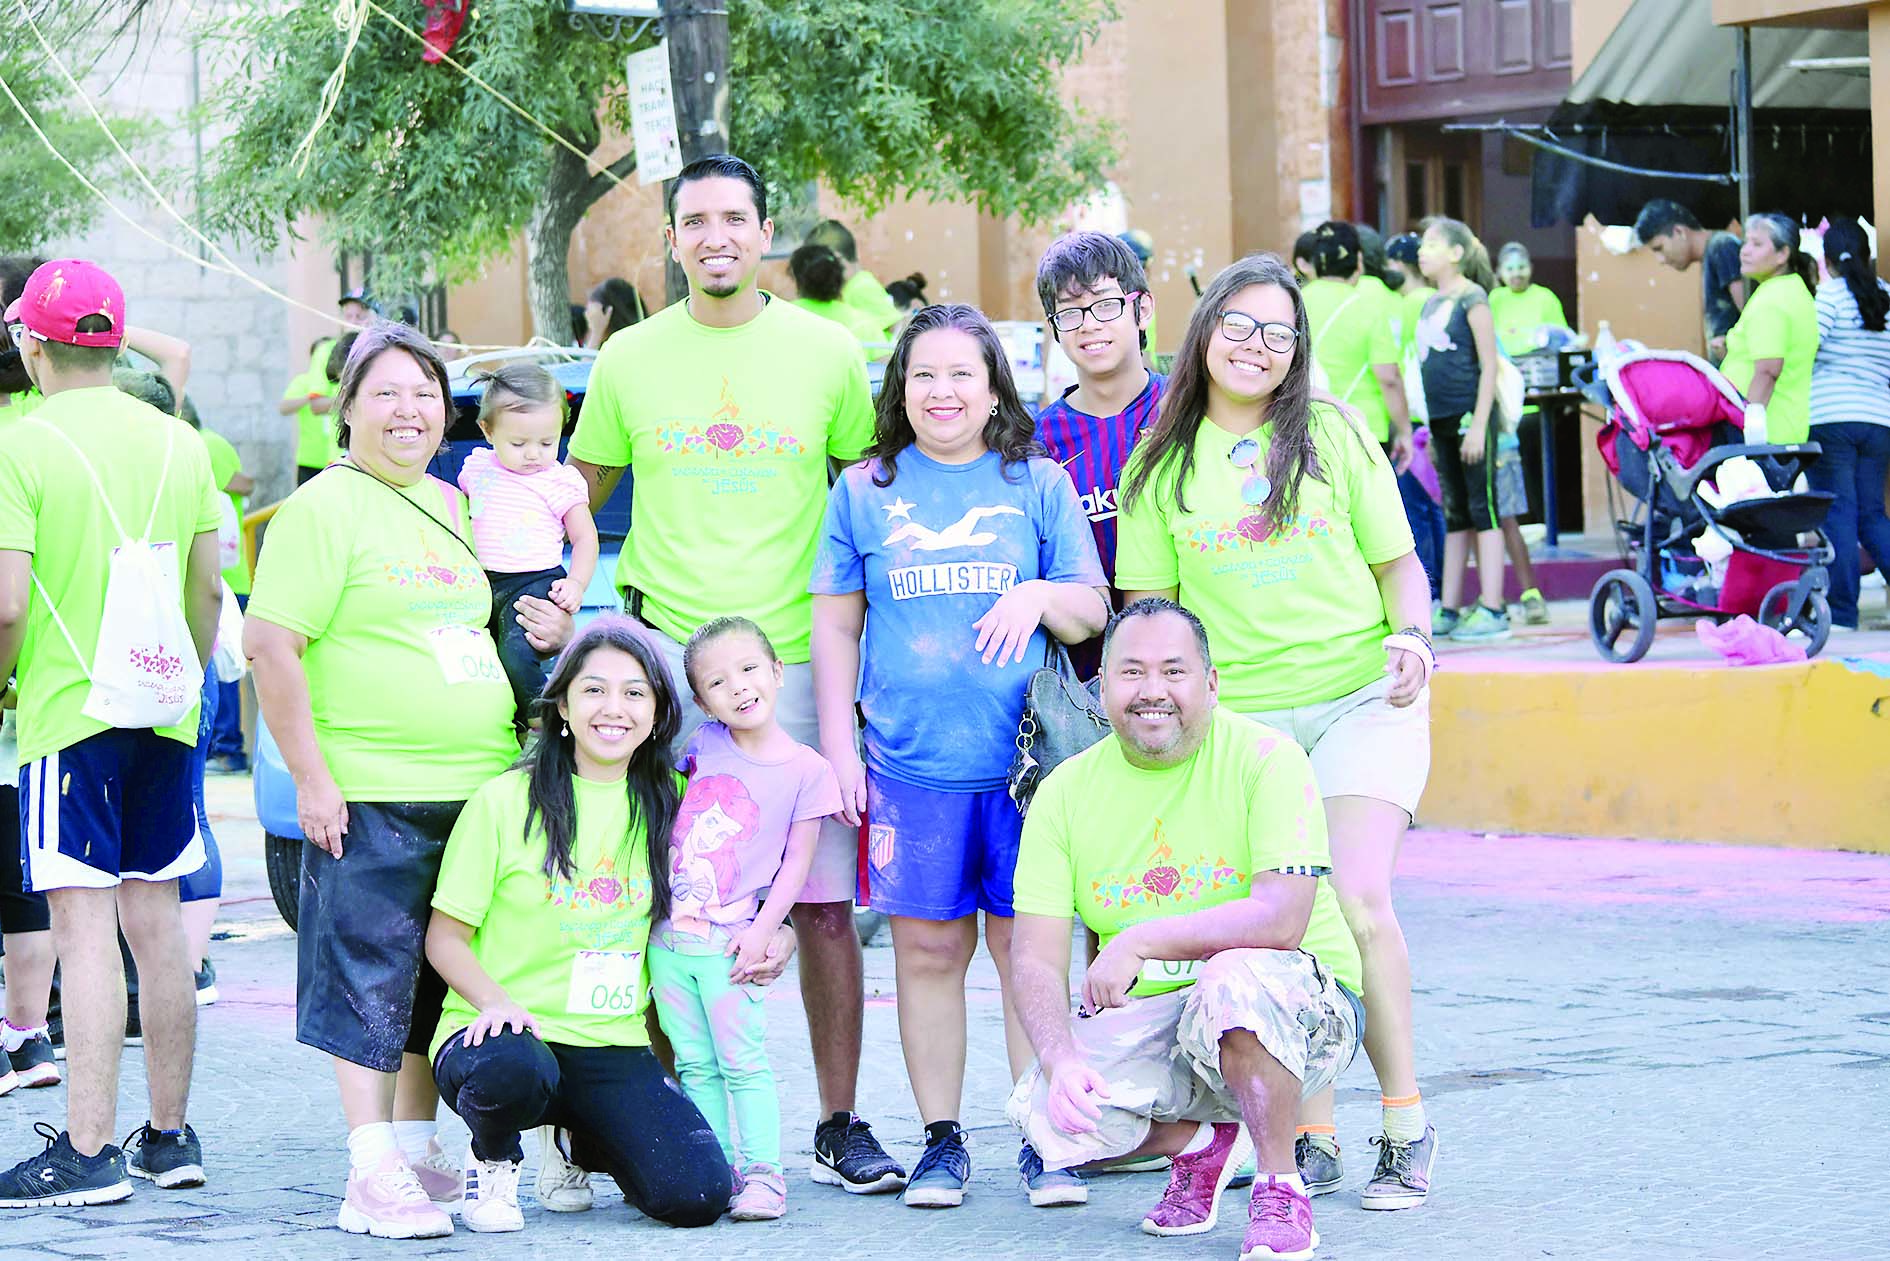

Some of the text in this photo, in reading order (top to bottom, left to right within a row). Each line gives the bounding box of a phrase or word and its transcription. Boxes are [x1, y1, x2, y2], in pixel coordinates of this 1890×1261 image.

[892, 566, 1012, 597] HOLLISTER
[462, 655, 501, 680] 066
[591, 984, 635, 1010] 065
